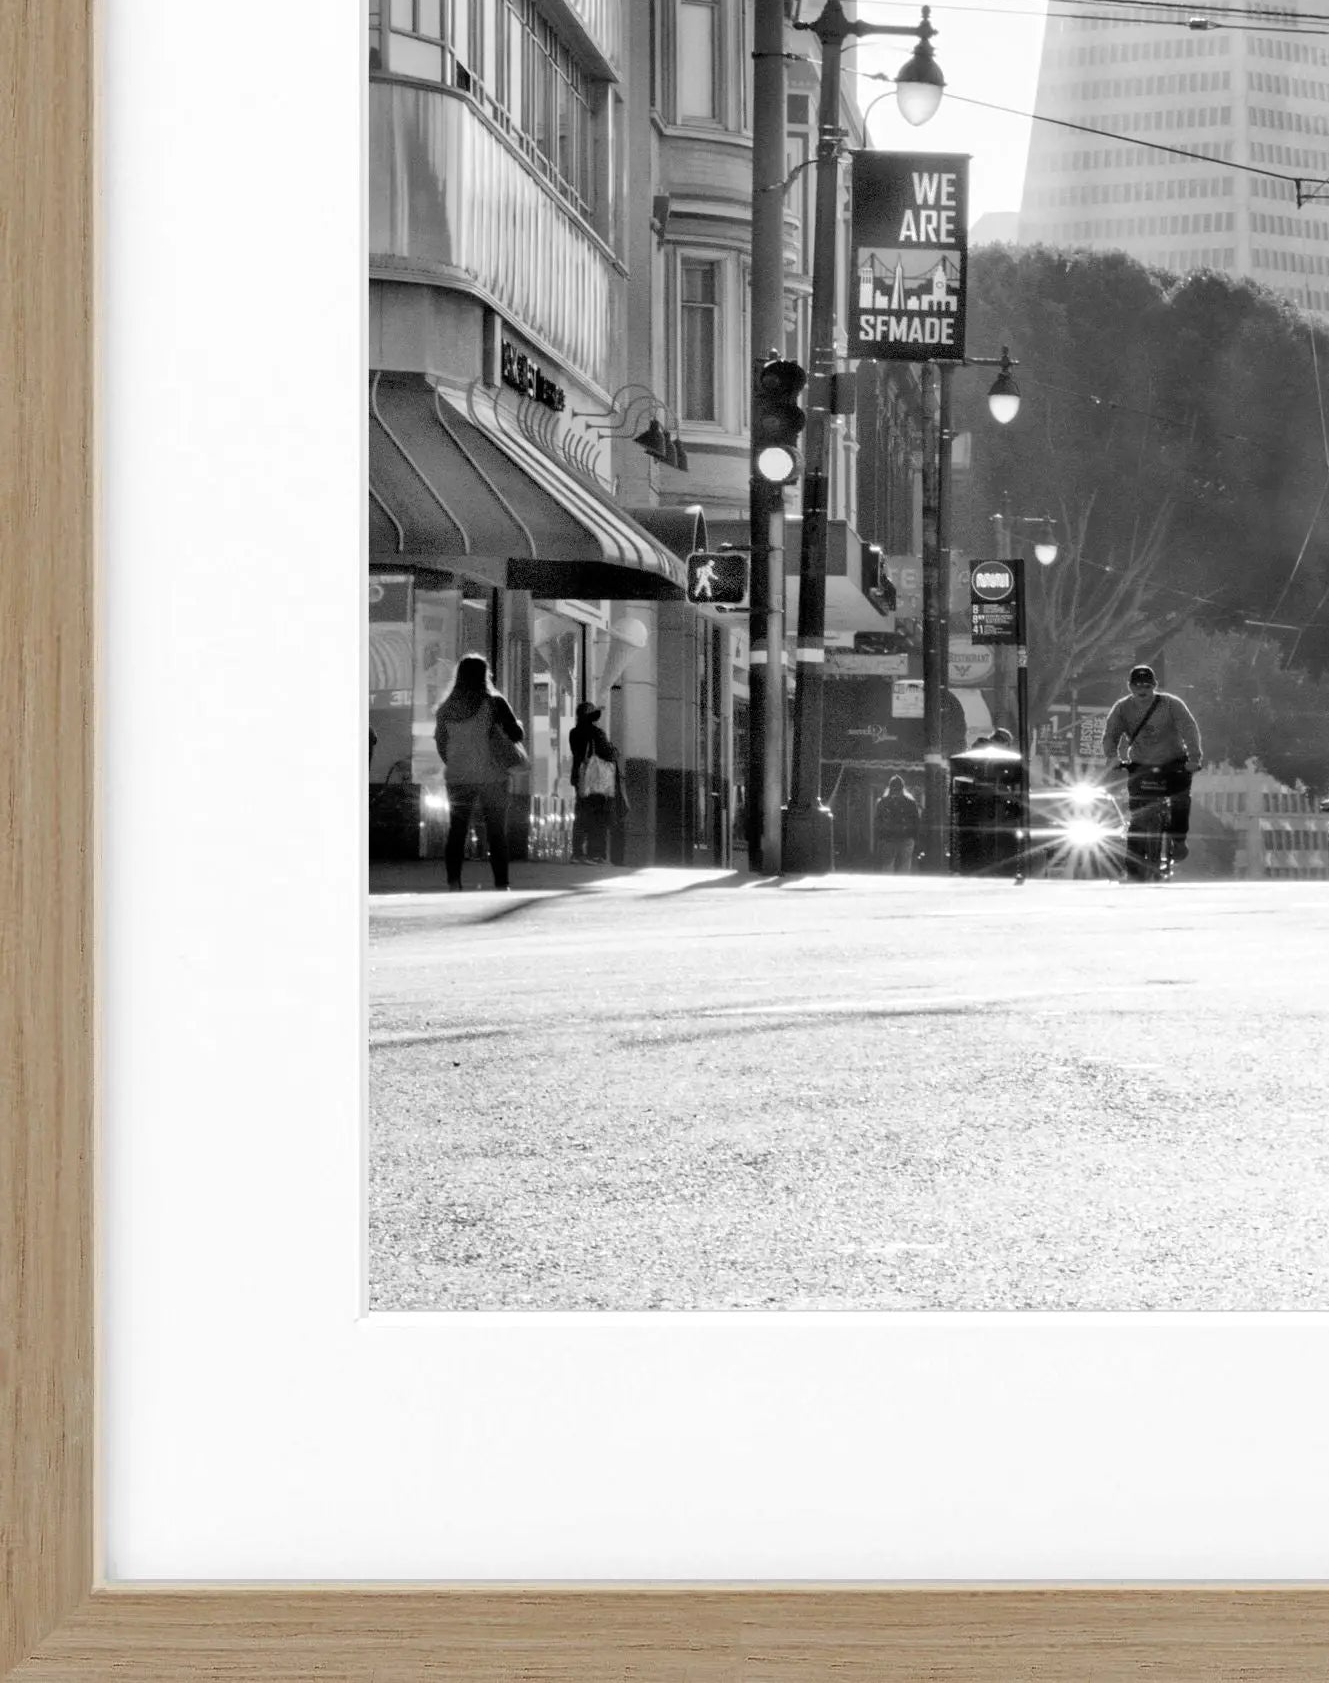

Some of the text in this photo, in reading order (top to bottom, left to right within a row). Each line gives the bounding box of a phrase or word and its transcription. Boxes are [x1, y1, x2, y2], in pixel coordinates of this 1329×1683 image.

[912, 172, 956, 206] WE
[899, 209, 956, 243] ARE
[859, 314, 955, 344] SFMADE
